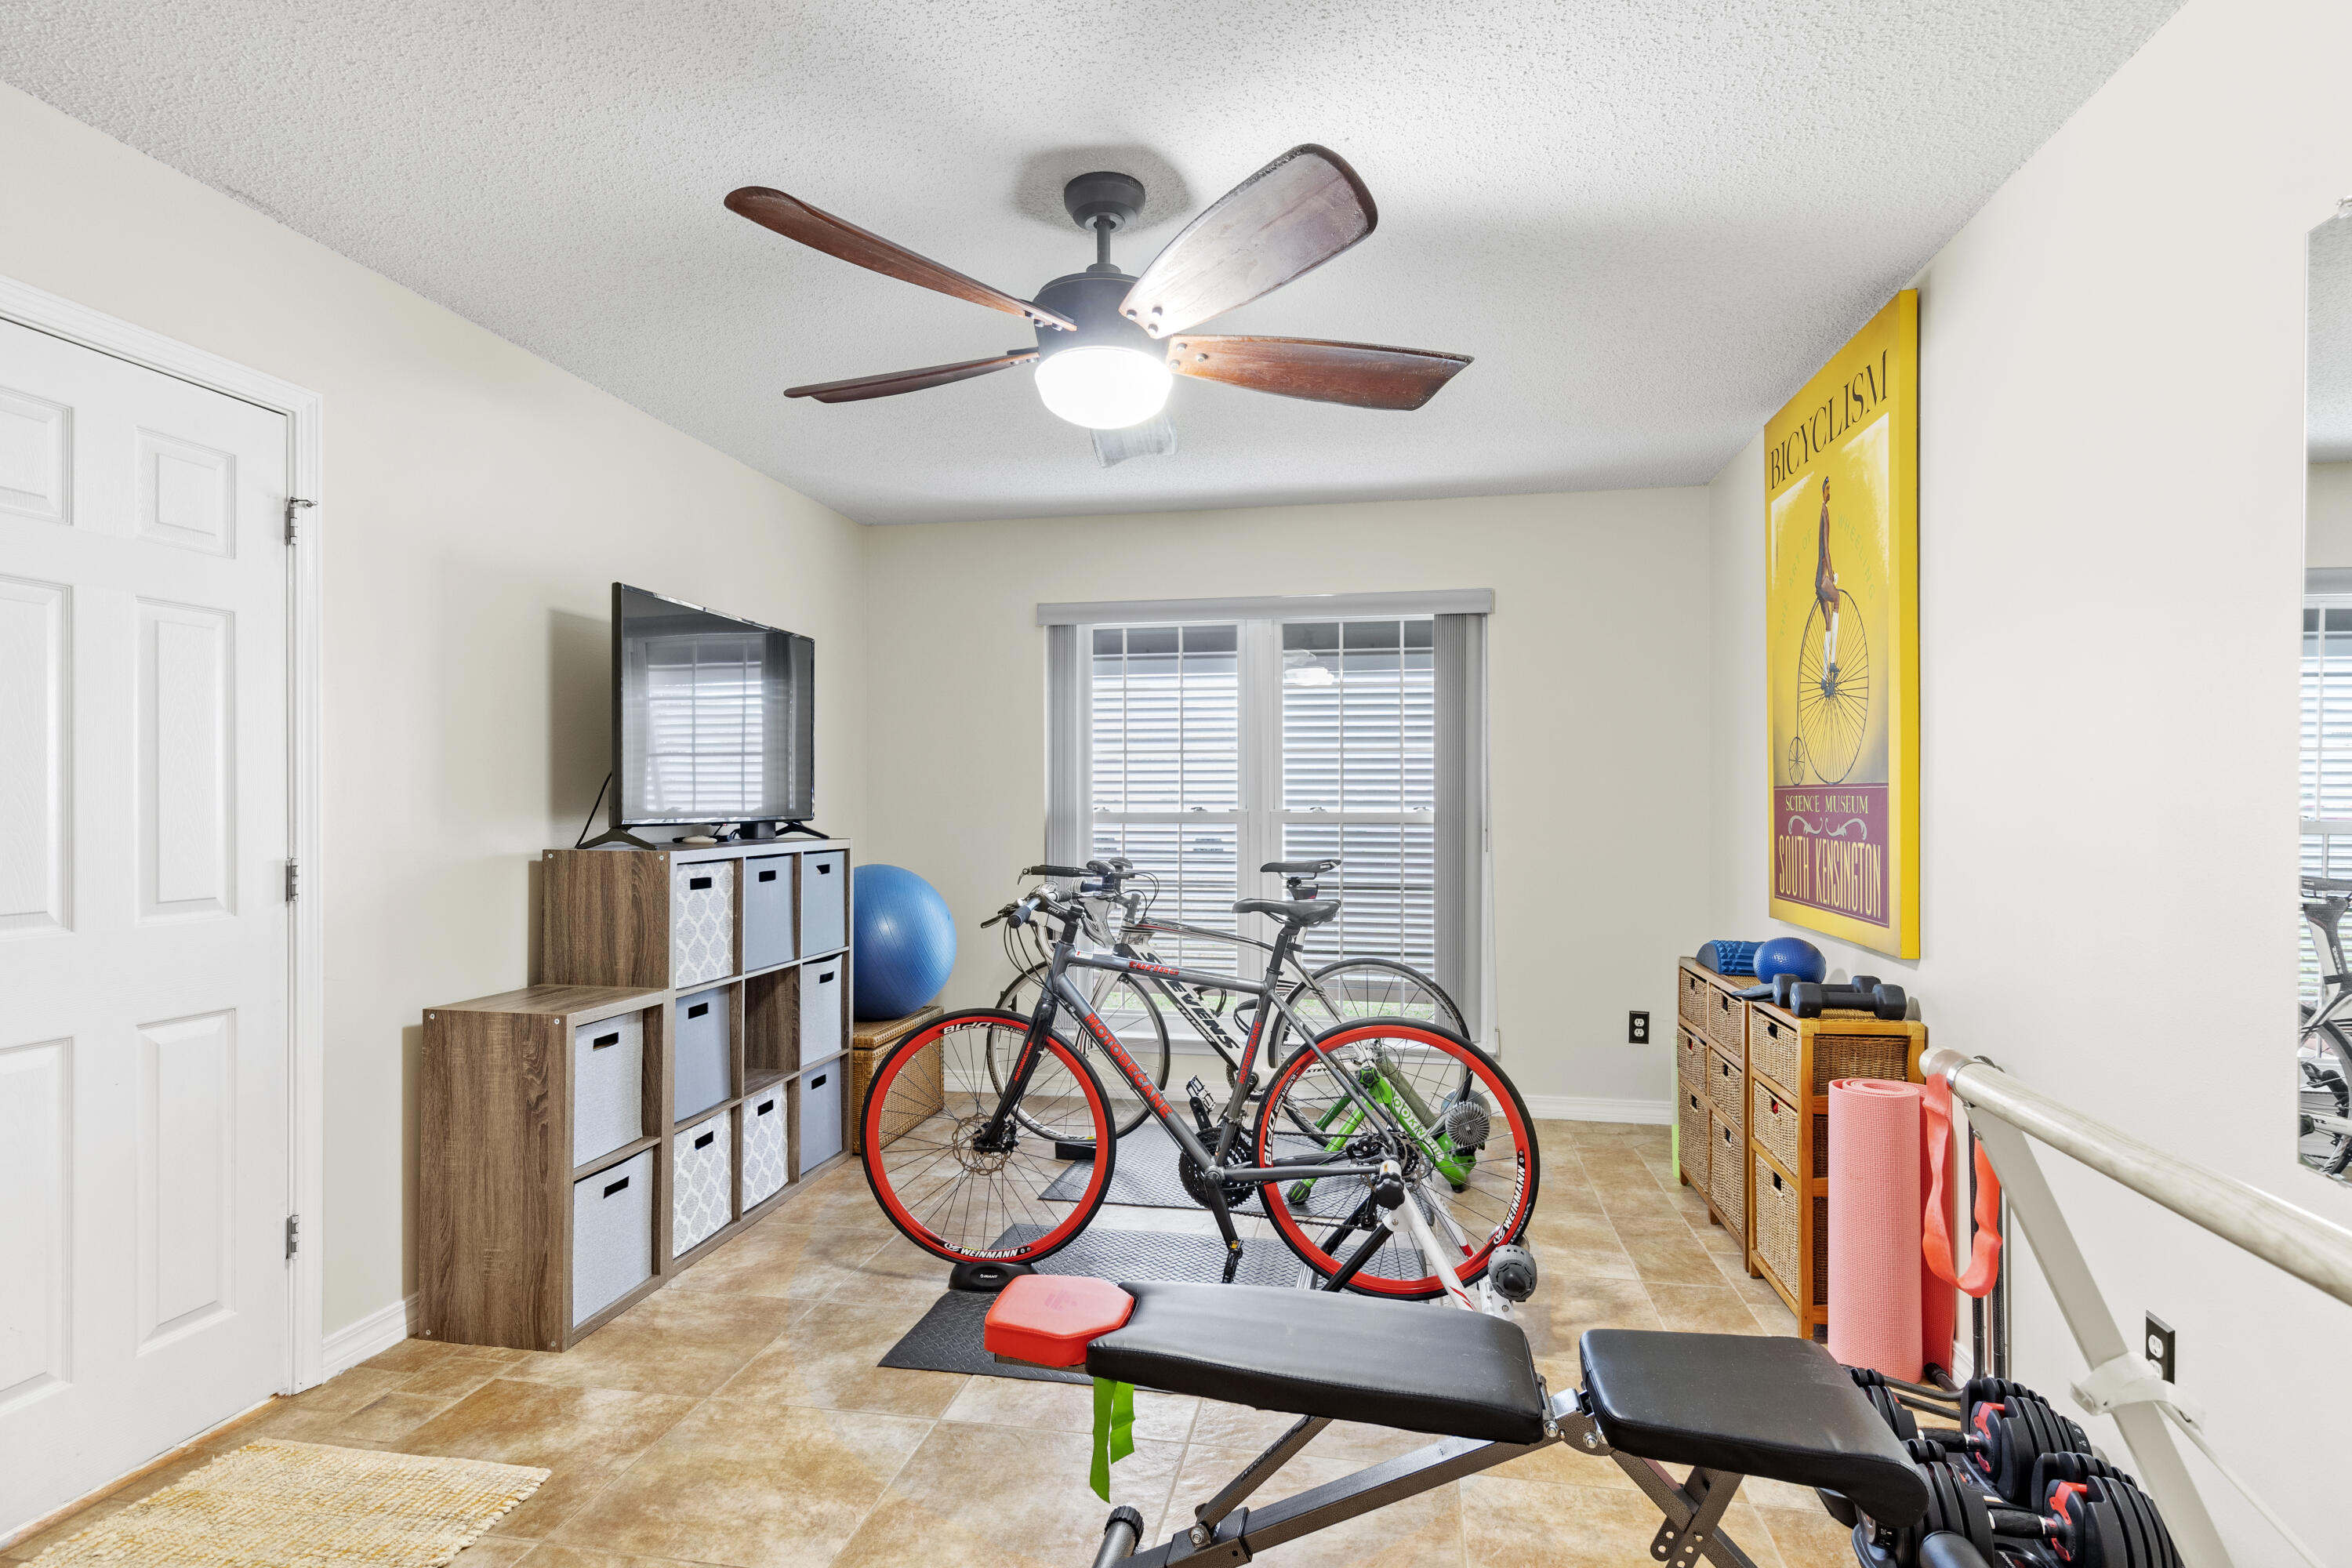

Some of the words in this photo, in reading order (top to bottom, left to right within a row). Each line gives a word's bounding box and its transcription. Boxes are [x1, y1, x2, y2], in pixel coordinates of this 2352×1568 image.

[1770, 348, 1888, 490] BICYCLISM
[1838, 514, 1875, 601] WHEELING
[1785, 795, 1820, 812] SCIENCE
[1825, 795, 1869, 814] MUSEUM
[1779, 834, 1809, 900] SOUTH
[1815, 837, 1881, 919] KENSINGTON
[943, 1022, 993, 1035] DP18
[1139, 952, 1240, 1049] SEVENS
[1014, 1041, 1033, 1081] MOTOBECANE
[1085, 1012, 1174, 1119] MOTOBECANE
[1239, 1021, 1262, 1084] MOTOBECANE
[1264, 1110, 1276, 1166] DP18
[1504, 1165, 1525, 1229] WEINMANN
[960, 1247, 1018, 1259] WEINMANN
